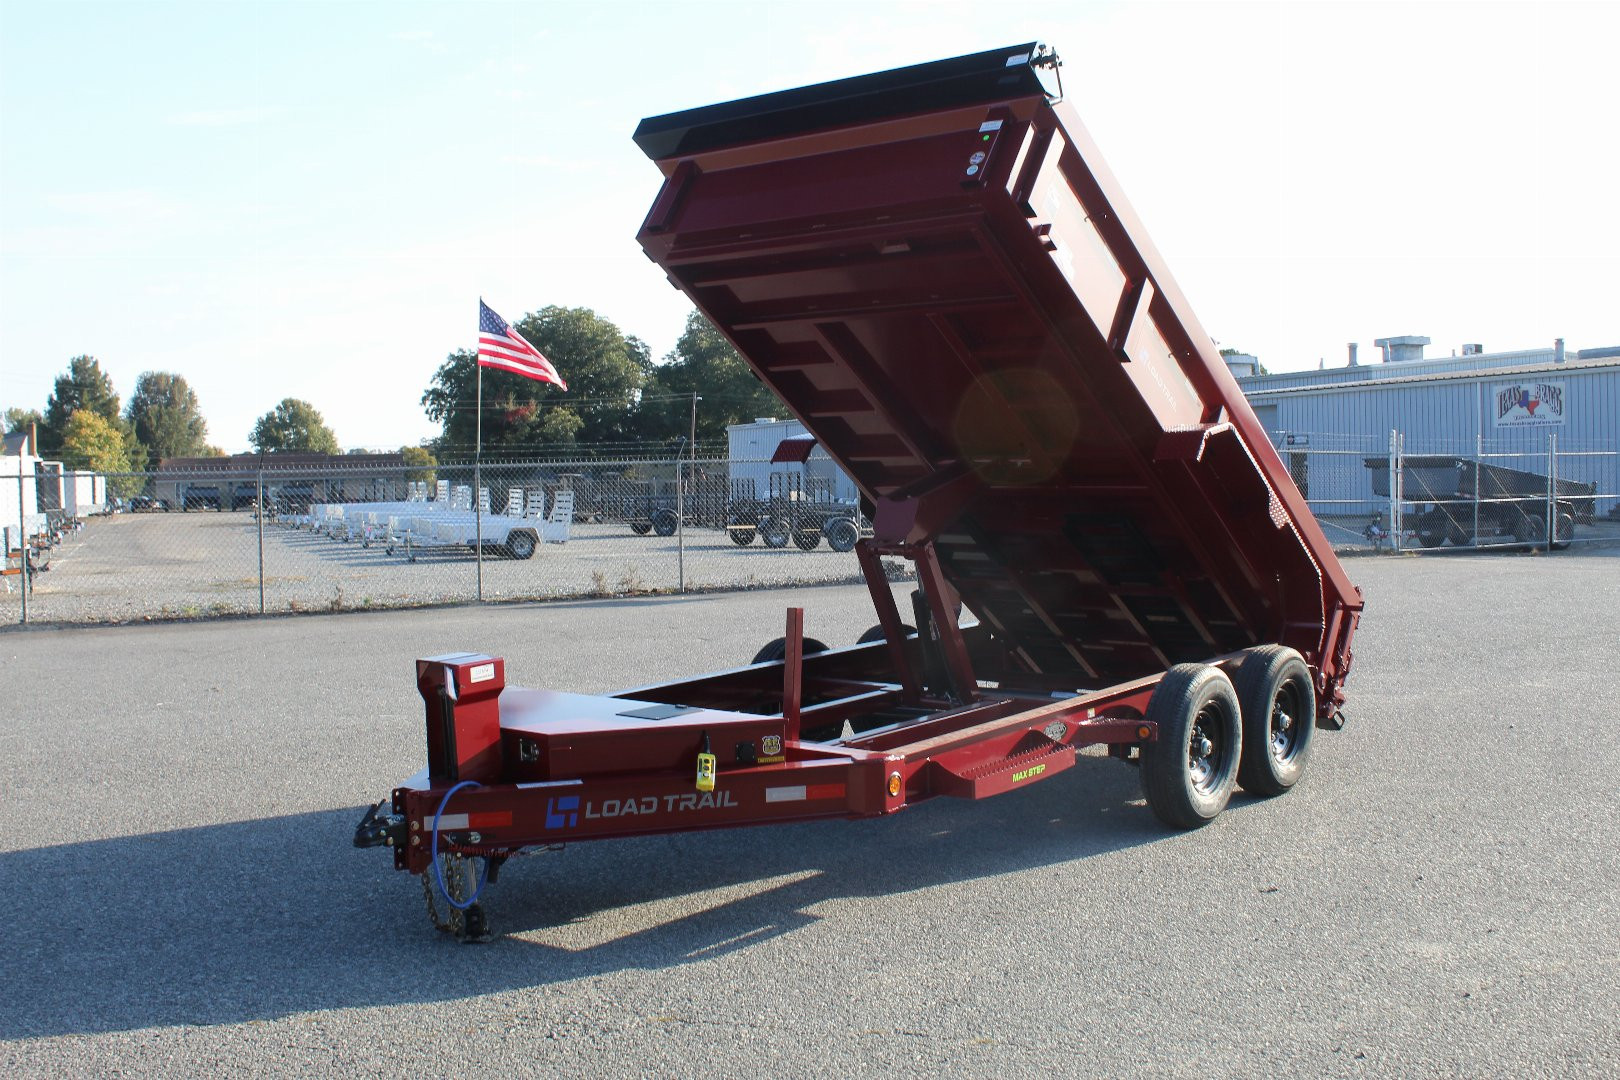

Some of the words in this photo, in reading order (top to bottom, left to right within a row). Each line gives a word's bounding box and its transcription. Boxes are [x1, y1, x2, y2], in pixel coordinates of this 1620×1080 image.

[1496, 385, 1521, 419] TEXAS
[1535, 384, 1562, 416] BRAGG
[1012, 769, 1028, 783] MAX
[1028, 763, 1046, 777] STEP
[584, 797, 659, 819] LOAD
[663, 790, 739, 812] TRAIL
